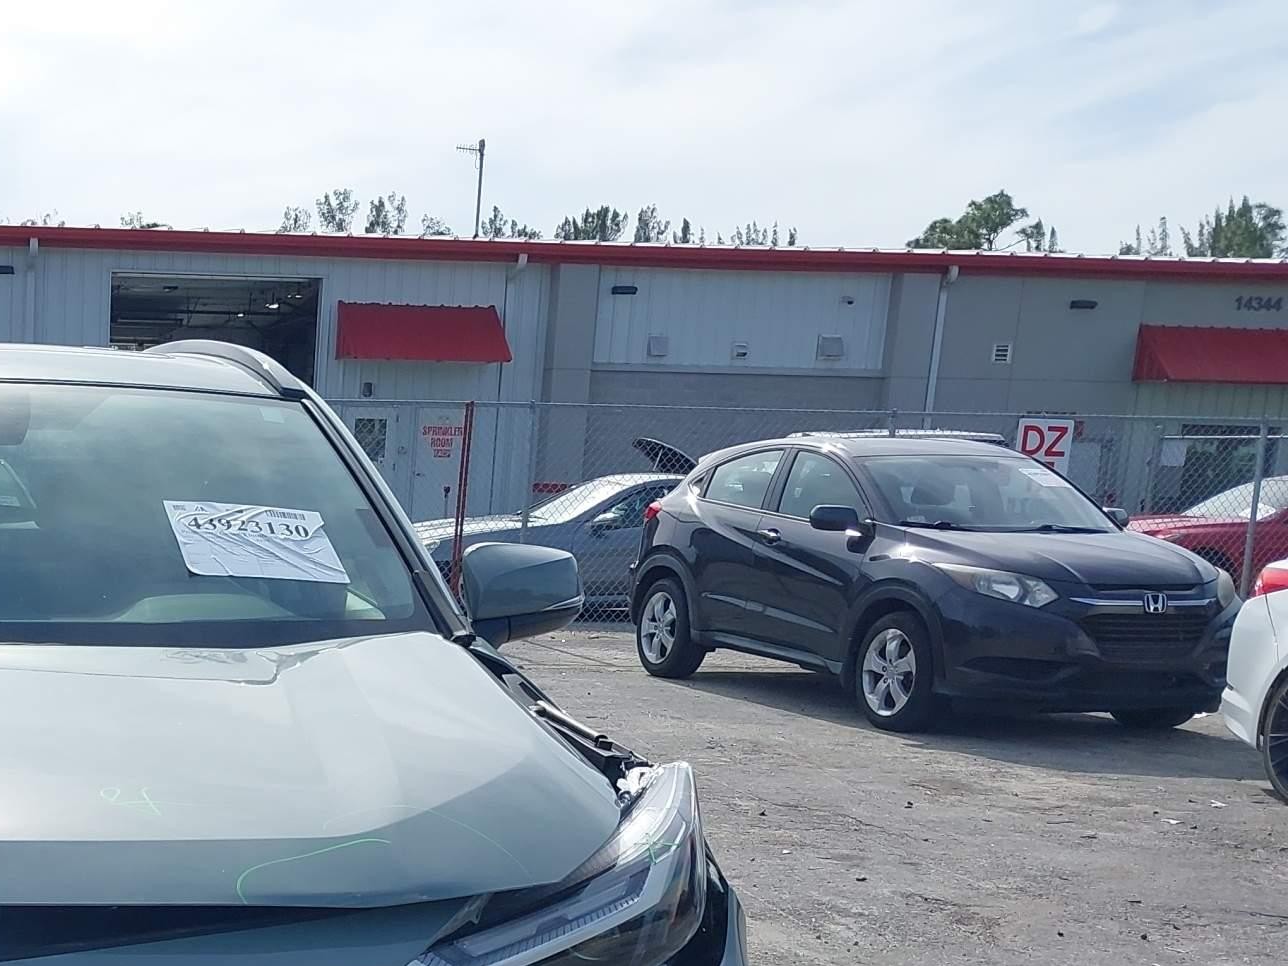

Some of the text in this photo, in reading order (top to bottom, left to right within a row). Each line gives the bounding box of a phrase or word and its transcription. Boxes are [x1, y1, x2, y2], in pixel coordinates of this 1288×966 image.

[1235, 296, 1283, 312] 14344
[431, 438, 453, 448] ROOM
[1021, 425, 1069, 457] DZ
[187, 516, 309, 539] 43923130
